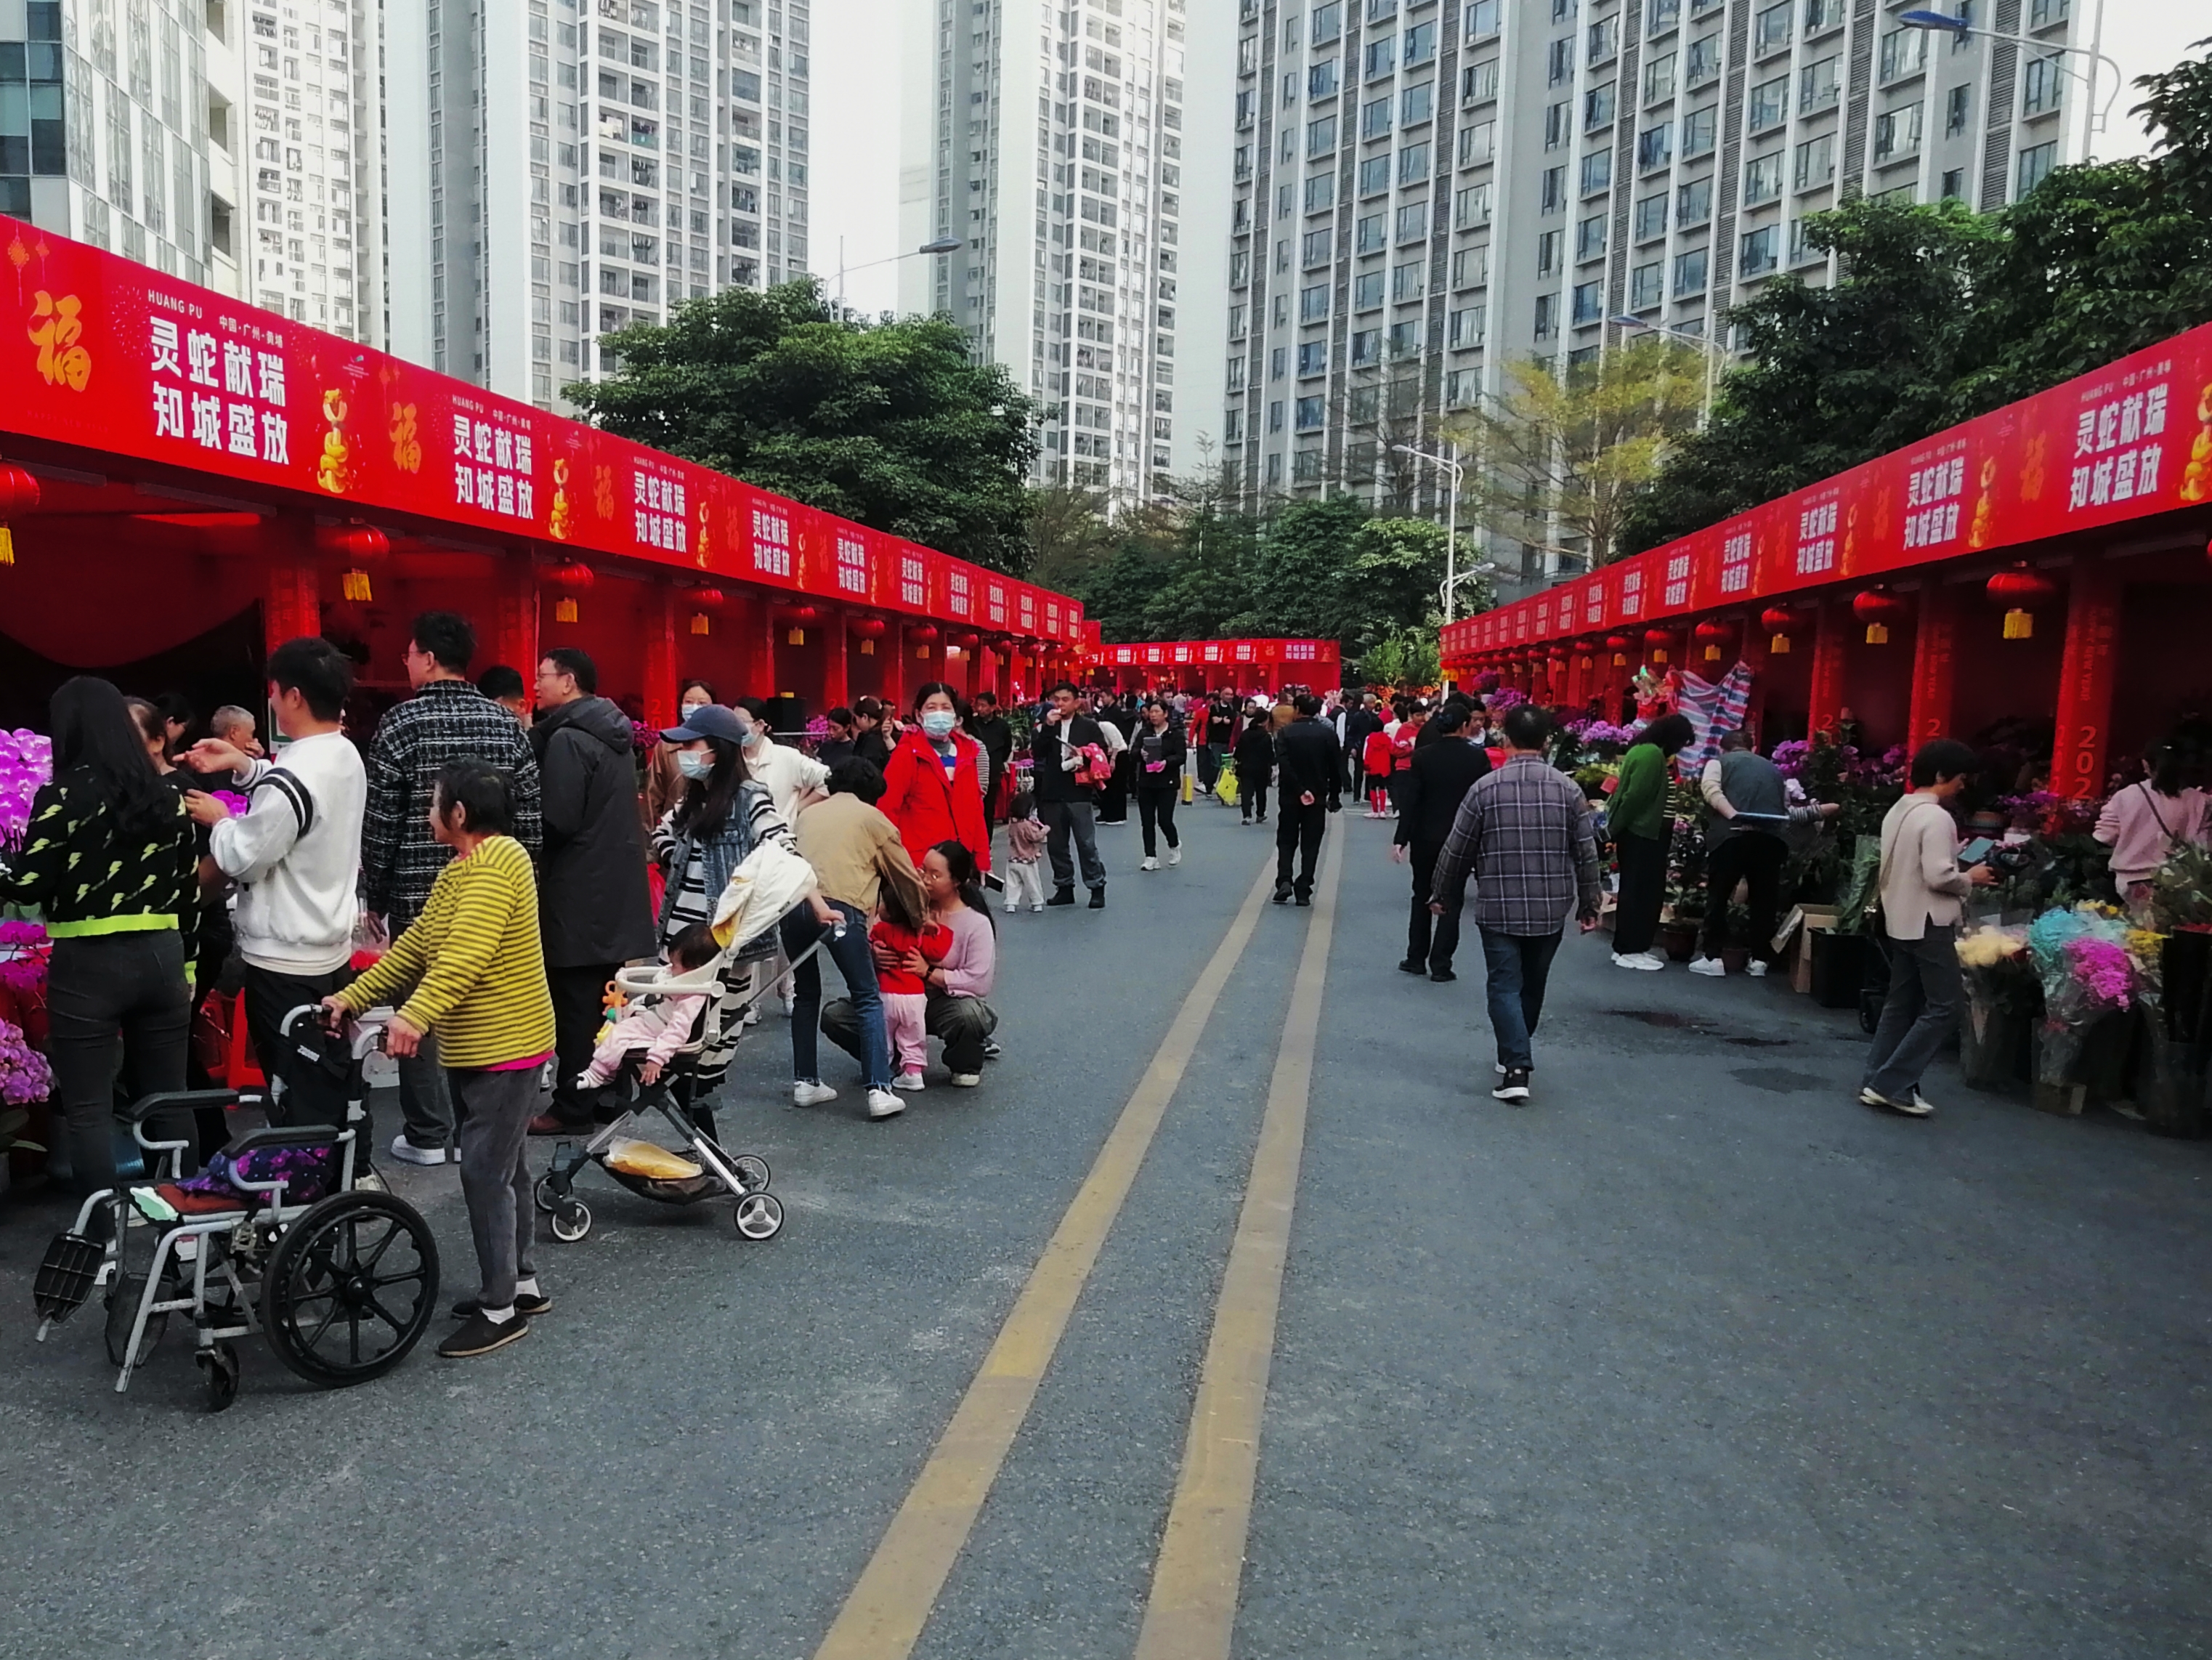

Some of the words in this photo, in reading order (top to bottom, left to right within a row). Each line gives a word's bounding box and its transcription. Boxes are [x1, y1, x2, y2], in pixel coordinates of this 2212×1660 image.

[148, 289, 185, 313] HUANG
[189, 304, 202, 318] PU
[28, 289, 92, 394] 福
[150, 316, 285, 407] 灵蛇献瑞
[153, 381, 288, 464] 知城盛放
[453, 395, 474, 410] HUANG
[475, 402, 484, 414] PU
[2075, 384, 2168, 458] 灵蛇献瑞
[389, 401, 422, 474] 福
[454, 414, 531, 474] 灵蛇献瑞
[455, 463, 533, 519] 知城盛放
[635, 471, 685, 516] 灵蛇献瑞
[1908, 457, 1964, 508] 灵蛇献瑞
[2069, 443, 2161, 511] 知城盛放
[636, 510, 686, 552] 知城盛放
[1904, 502, 1959, 549] 知城盛放
